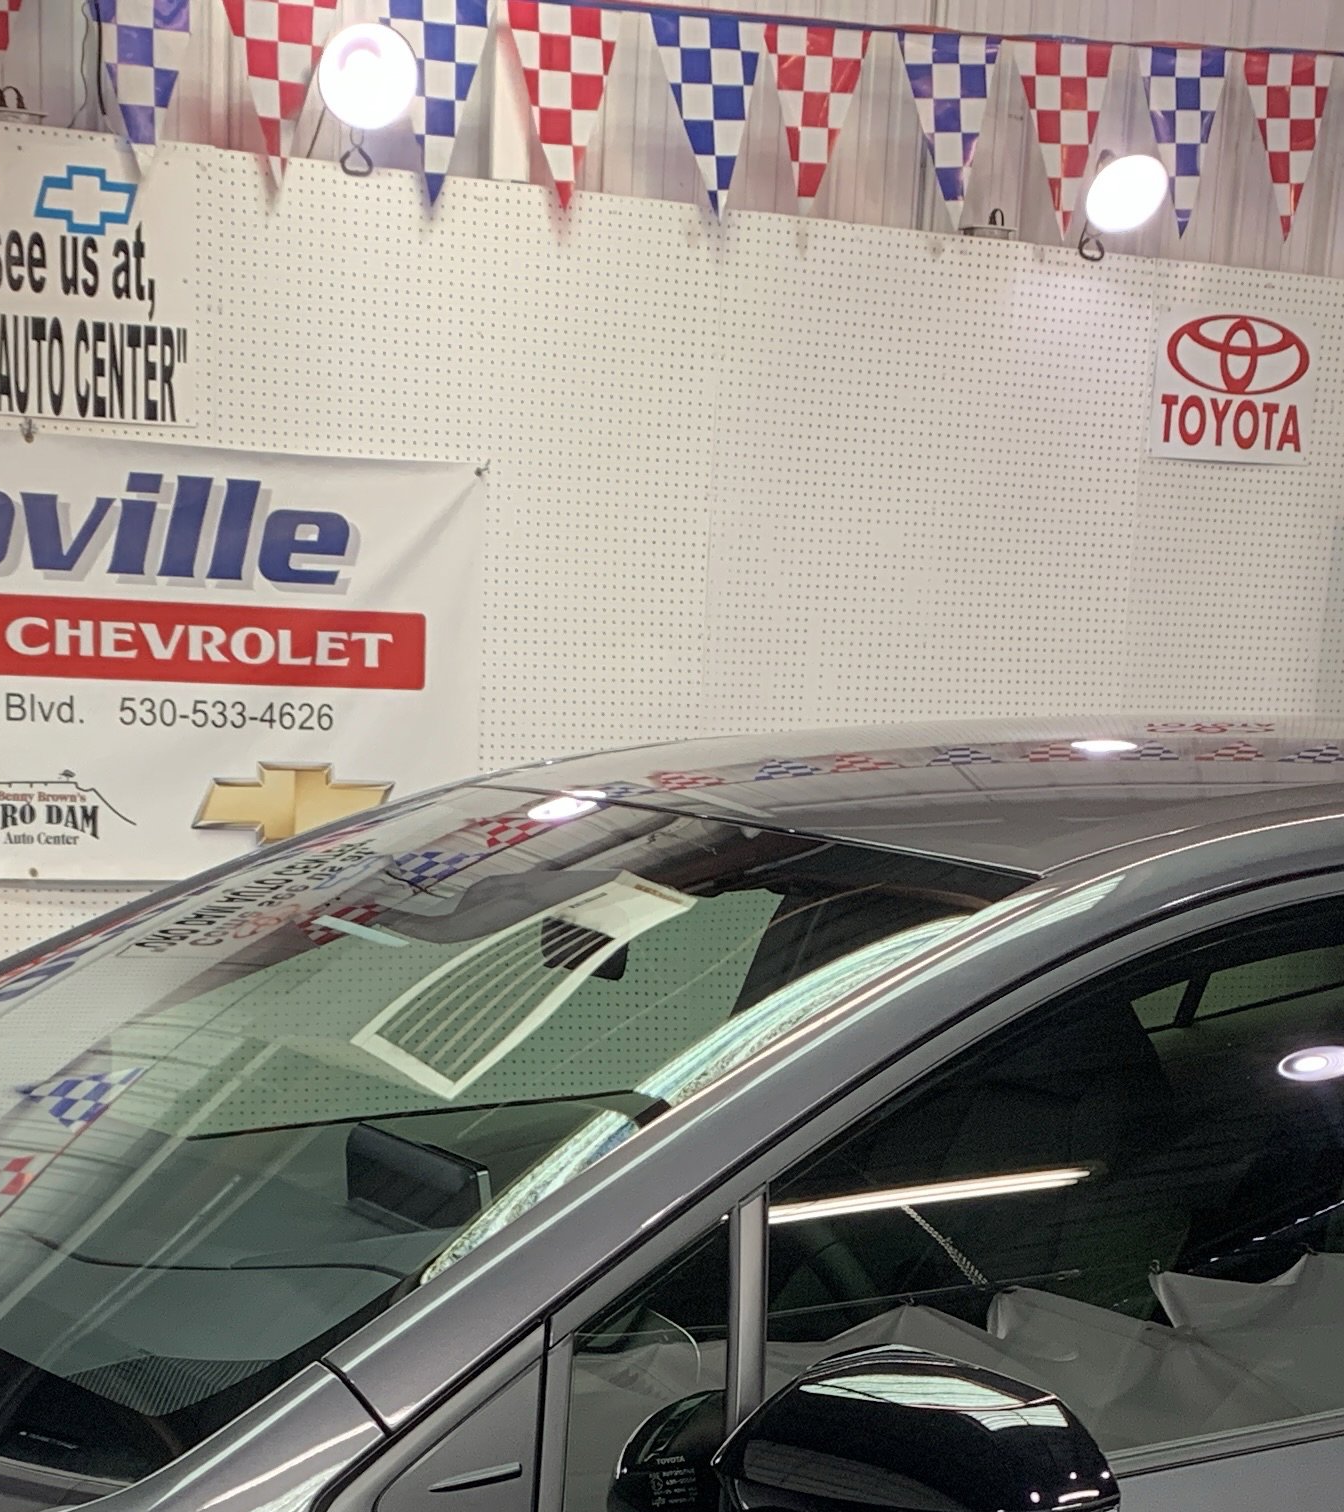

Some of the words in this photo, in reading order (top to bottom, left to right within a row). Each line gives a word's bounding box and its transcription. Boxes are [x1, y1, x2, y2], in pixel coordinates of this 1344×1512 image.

[60, 234, 99, 298] us
[112, 220, 156, 321] at,
[74, 317, 188, 423] CENTER"
[1161, 393, 1302, 453] TOYOTA
[6, 616, 394, 670] CHEVROLET
[5, 694, 85, 727] Blvd.
[119, 696, 335, 733] 530-533-4626
[37, 791, 87, 804] Brown's
[3, 831, 35, 845] Auto
[36, 832, 80, 846] Center
[45, 803, 99, 840] DAM
